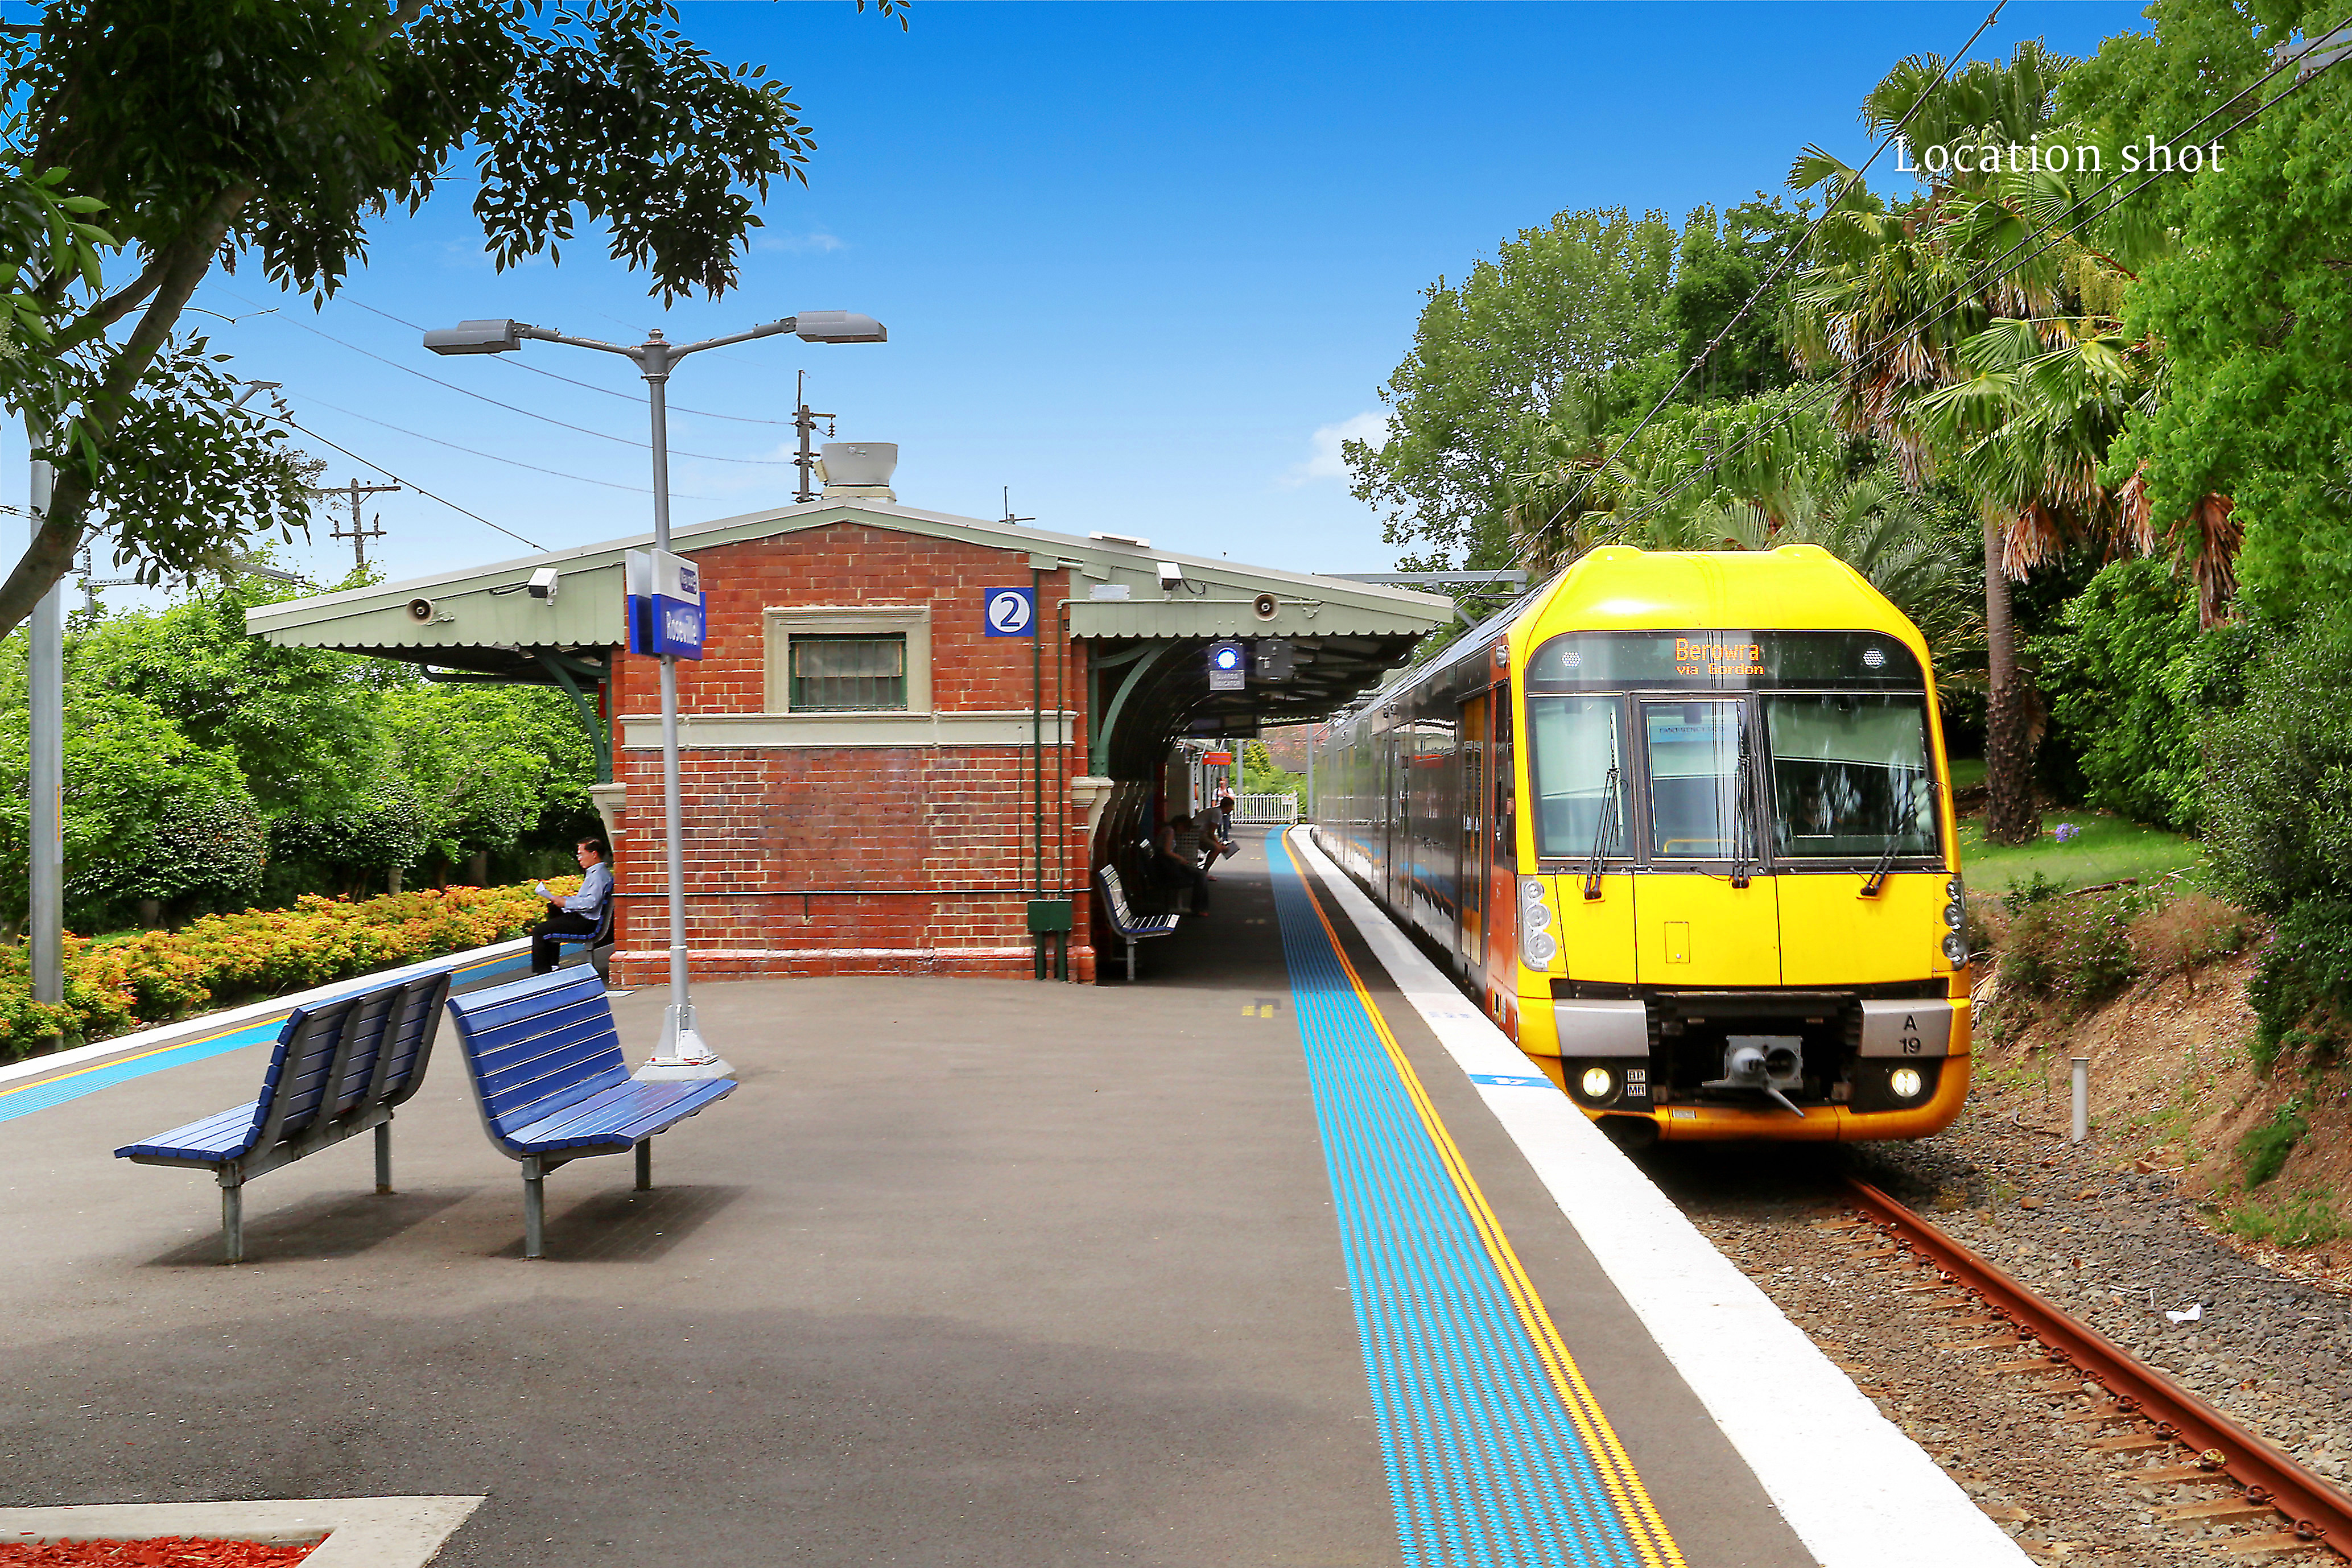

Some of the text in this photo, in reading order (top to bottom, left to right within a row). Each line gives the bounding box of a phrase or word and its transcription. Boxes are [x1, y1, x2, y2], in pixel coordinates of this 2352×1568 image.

[1001, 596, 1020, 626] 2
[1676, 637, 1760, 661] Berowra
[1676, 662, 1764, 675] via Gordon
[1904, 1014, 1917, 1031] A
[1899, 1037, 1921, 1054] 19
